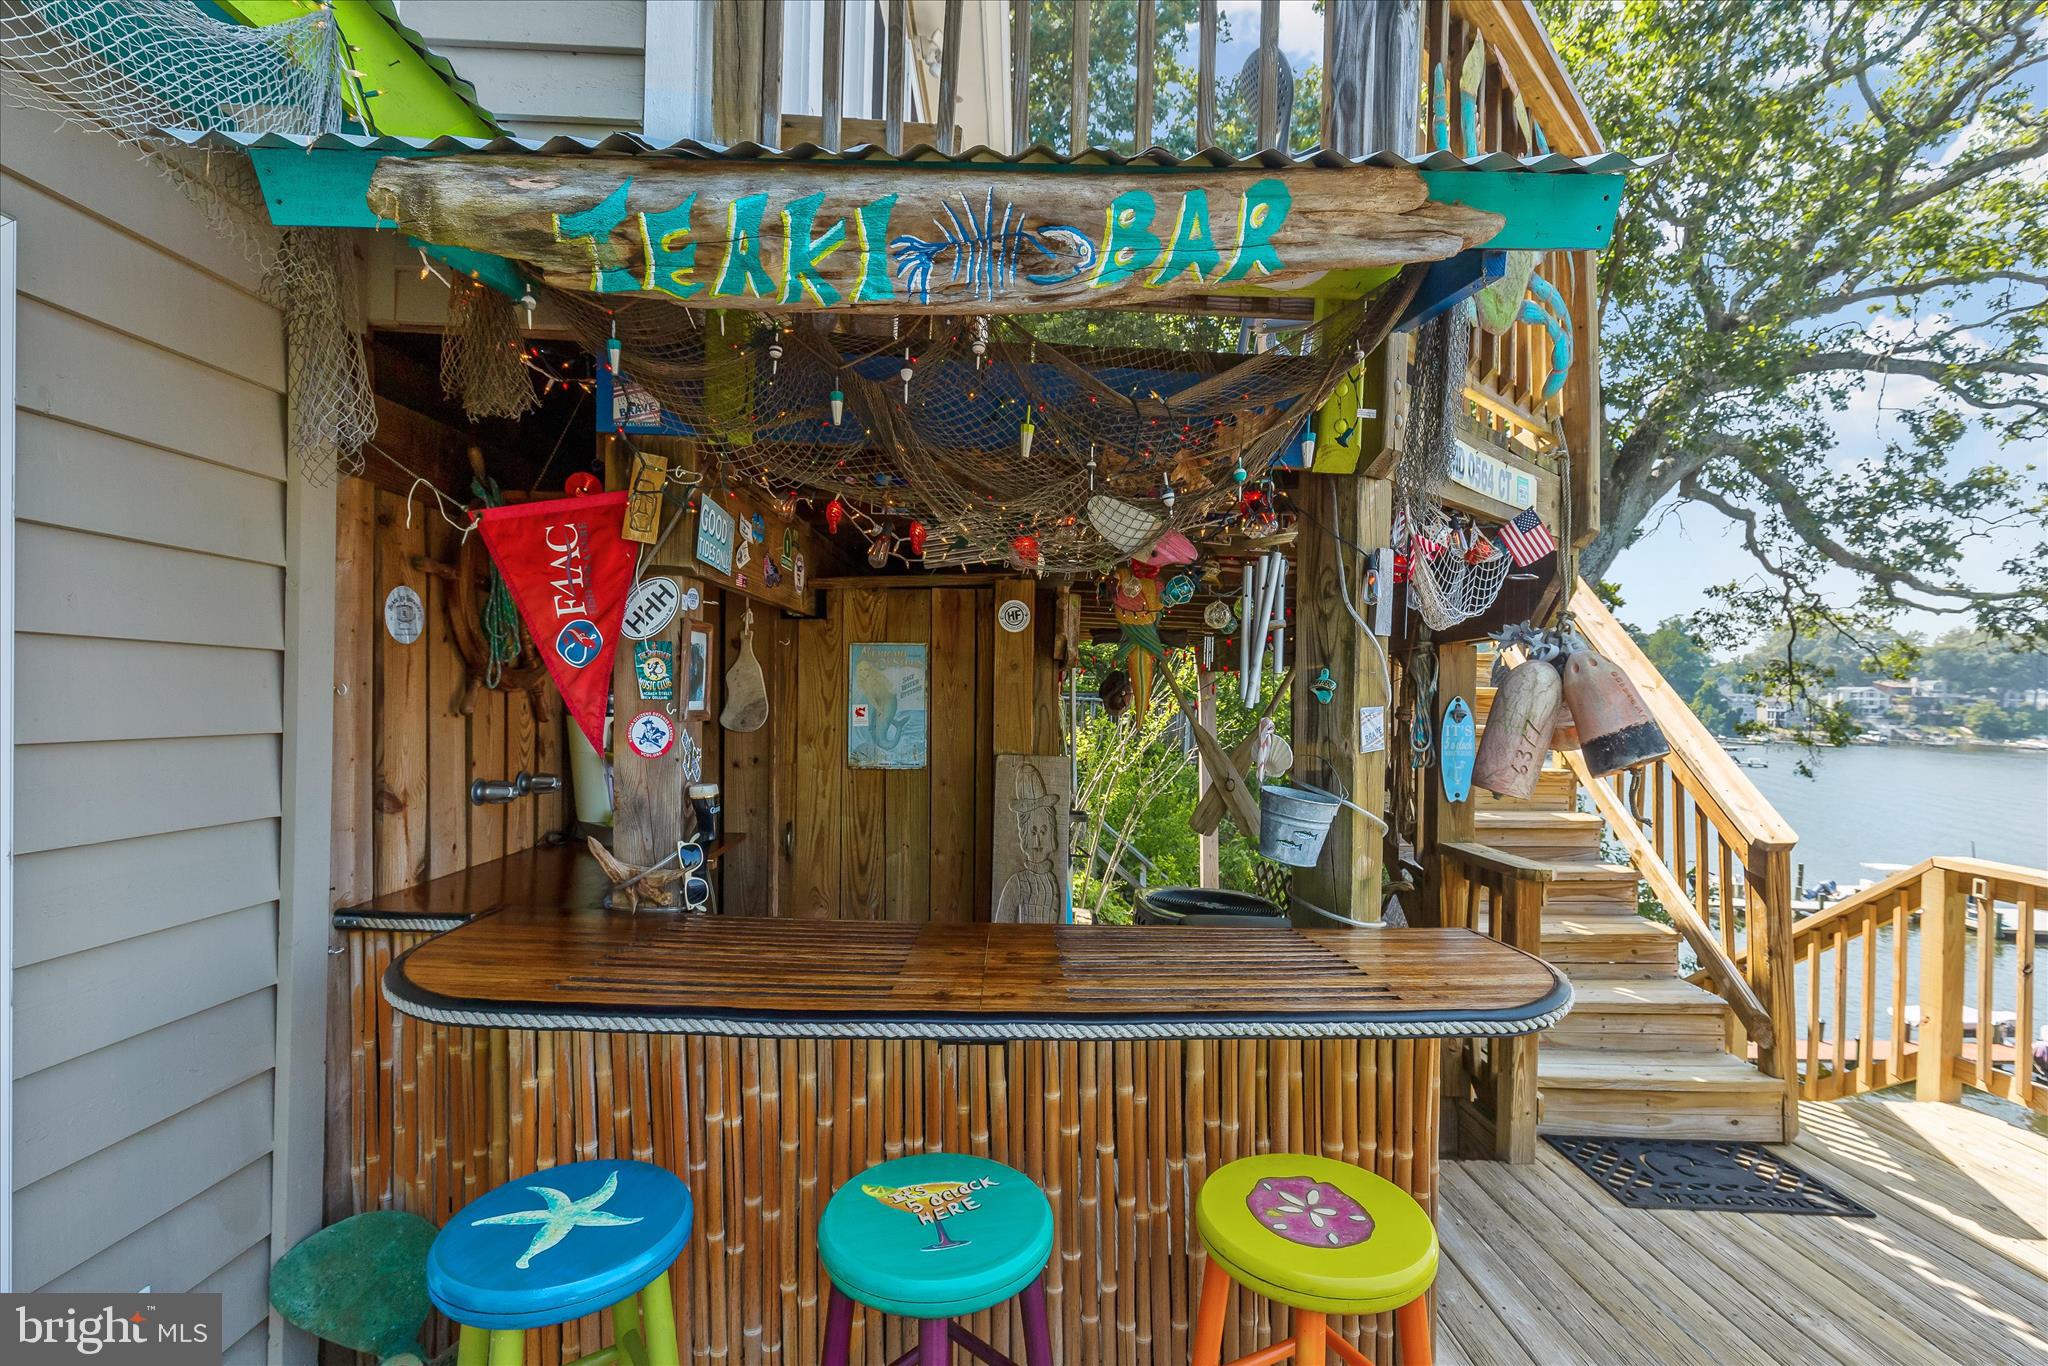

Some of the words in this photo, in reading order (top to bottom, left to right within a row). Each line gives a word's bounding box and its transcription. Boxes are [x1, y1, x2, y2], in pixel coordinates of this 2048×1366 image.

[552, 176, 899, 308] TEAKI
[1089, 178, 1293, 290] BAR
[1468, 453, 1494, 495] 0564
[1499, 468, 1512, 501] CT
[701, 503, 728, 545] GOOD
[699, 537, 716, 561] TIDES
[1007, 609, 1021, 621] HF
[639, 677, 656, 691] MUSIC
[657, 677, 672, 690] CLUB
[1446, 724, 1473, 737] IT'S
[1510, 718, 1541, 776] 6377
[905, 1199, 924, 1214] 5
[917, 1196, 982, 1226] HERE
